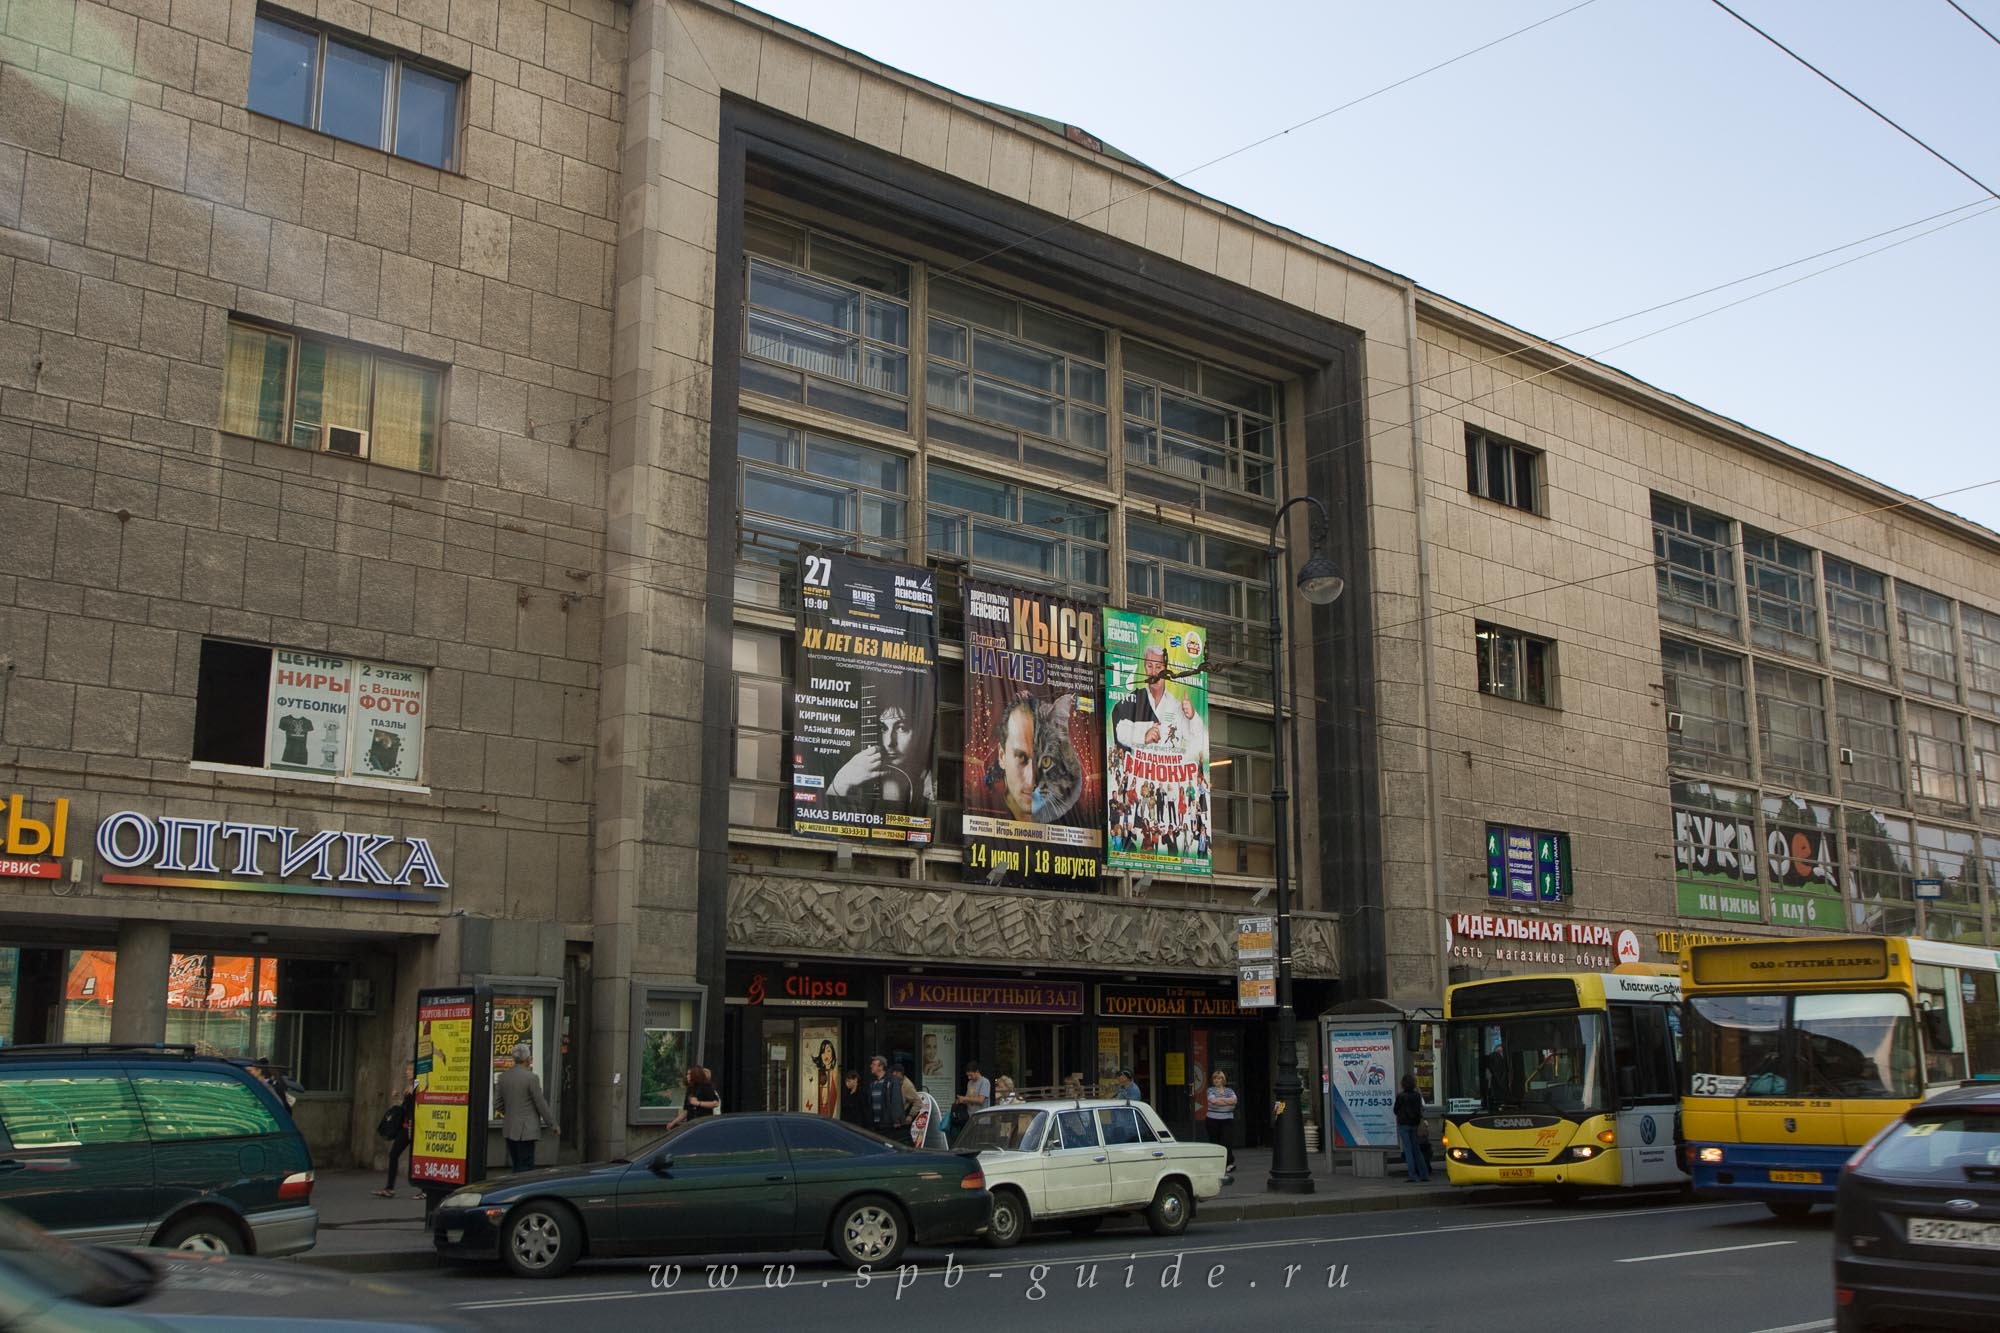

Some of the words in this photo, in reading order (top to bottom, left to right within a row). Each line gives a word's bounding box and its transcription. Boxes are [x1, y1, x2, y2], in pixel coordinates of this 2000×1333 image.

[803, 555, 832, 587] 27
[804, 597, 829, 610] 19:00
[852, 590, 876, 602] BLUES
[894, 588, 934, 604] ЛЕНСОВЕТА
[970, 601, 1010, 623] ЛЕНСОВЕТА
[1013, 597, 1093, 663] КЫСЯ
[824, 632, 853, 653] ЛЕТ
[853, 637, 879, 656] БЕЗ
[970, 632, 1007, 649] Дмитрий
[277, 652, 343, 670] ЦЕНТР
[969, 645, 1046, 686] НАГИЕВ
[277, 669, 350, 693] НИРЫ
[362, 666, 371, 677] 2
[375, 669, 413, 682] этаж
[1110, 662, 1138, 690] 17
[359, 684, 367, 692] с
[372, 683, 421, 699] Вашим
[810, 677, 852, 693] ПИЛОТ
[277, 696, 347, 715] ФУТБОЛКИ
[359, 694, 420, 716] ФОТО
[794, 693, 859, 710] КУКРЫНИКСЫ
[371, 718, 407, 730] ПАЗЛЫ
[799, 710, 841, 723] КИРПИЧИ
[804, 725, 833, 735] РАЗНЫЕ
[833, 727, 856, 737] ЛЮДИ
[794, 735, 821, 744] АЛЕКСЕЙ
[821, 738, 851, 748] МУРАШОВ
[1135, 750, 1183, 765] ВЛАДИМИР
[1125, 754, 1198, 783] ВИНОКУР
[797, 807, 830, 820] ЗАКАЗ
[832, 811, 884, 825] БИЛЕТОВ:
[996, 826, 1013, 837] Игорь
[1013, 828, 1043, 839] ЛИФАНОВ
[97, 810, 450, 889] ОПТИКА
[970, 843, 986, 868] 14
[990, 849, 1020, 871] июля
[1034, 850, 1050, 873] 18
[1054, 856, 1096, 880] августа
[1456, 914, 1563, 942] ИДЕАЛЬНАЯ
[1570, 924, 1613, 946] ПАРА
[1454, 946, 1482, 959] сеть
[1496, 948, 1565, 965] магазинов
[1576, 952, 1611, 969] обуви
[785, 976, 848, 999] Clipsa
[919, 984, 1043, 1007] КОНЦЕРТНЫЙ
[1045, 990, 1078, 1007] ЗАЛ
[1620, 979, 1682, 995] Классика-офи
[1105, 995, 1185, 1014] ТОРГОВАЯ
[494, 1034, 519, 1044] DEEP
[494, 1045, 514, 1055] FOR
[1334, 1045, 1391, 1053] ОБЩЕРОССИЙСКИЙ
[1344, 1089, 1371, 1097] ГОРЯЧАЯ
[1371, 1089, 1393, 1097] ЛИНИЯ
[1693, 1076, 1719, 1095] 25
[1347, 1098, 1393, 1107] 777-55-33
[432, 1110, 451, 1120] МЕСТА
[1493, 1118, 1534, 1128] SCANIA
[425, 1130, 457, 1141] ТОРГОВЛЮ
[431, 1143, 455, 1153] ОФИСЫ
[424, 1162, 460, 1179] 346-40-84
